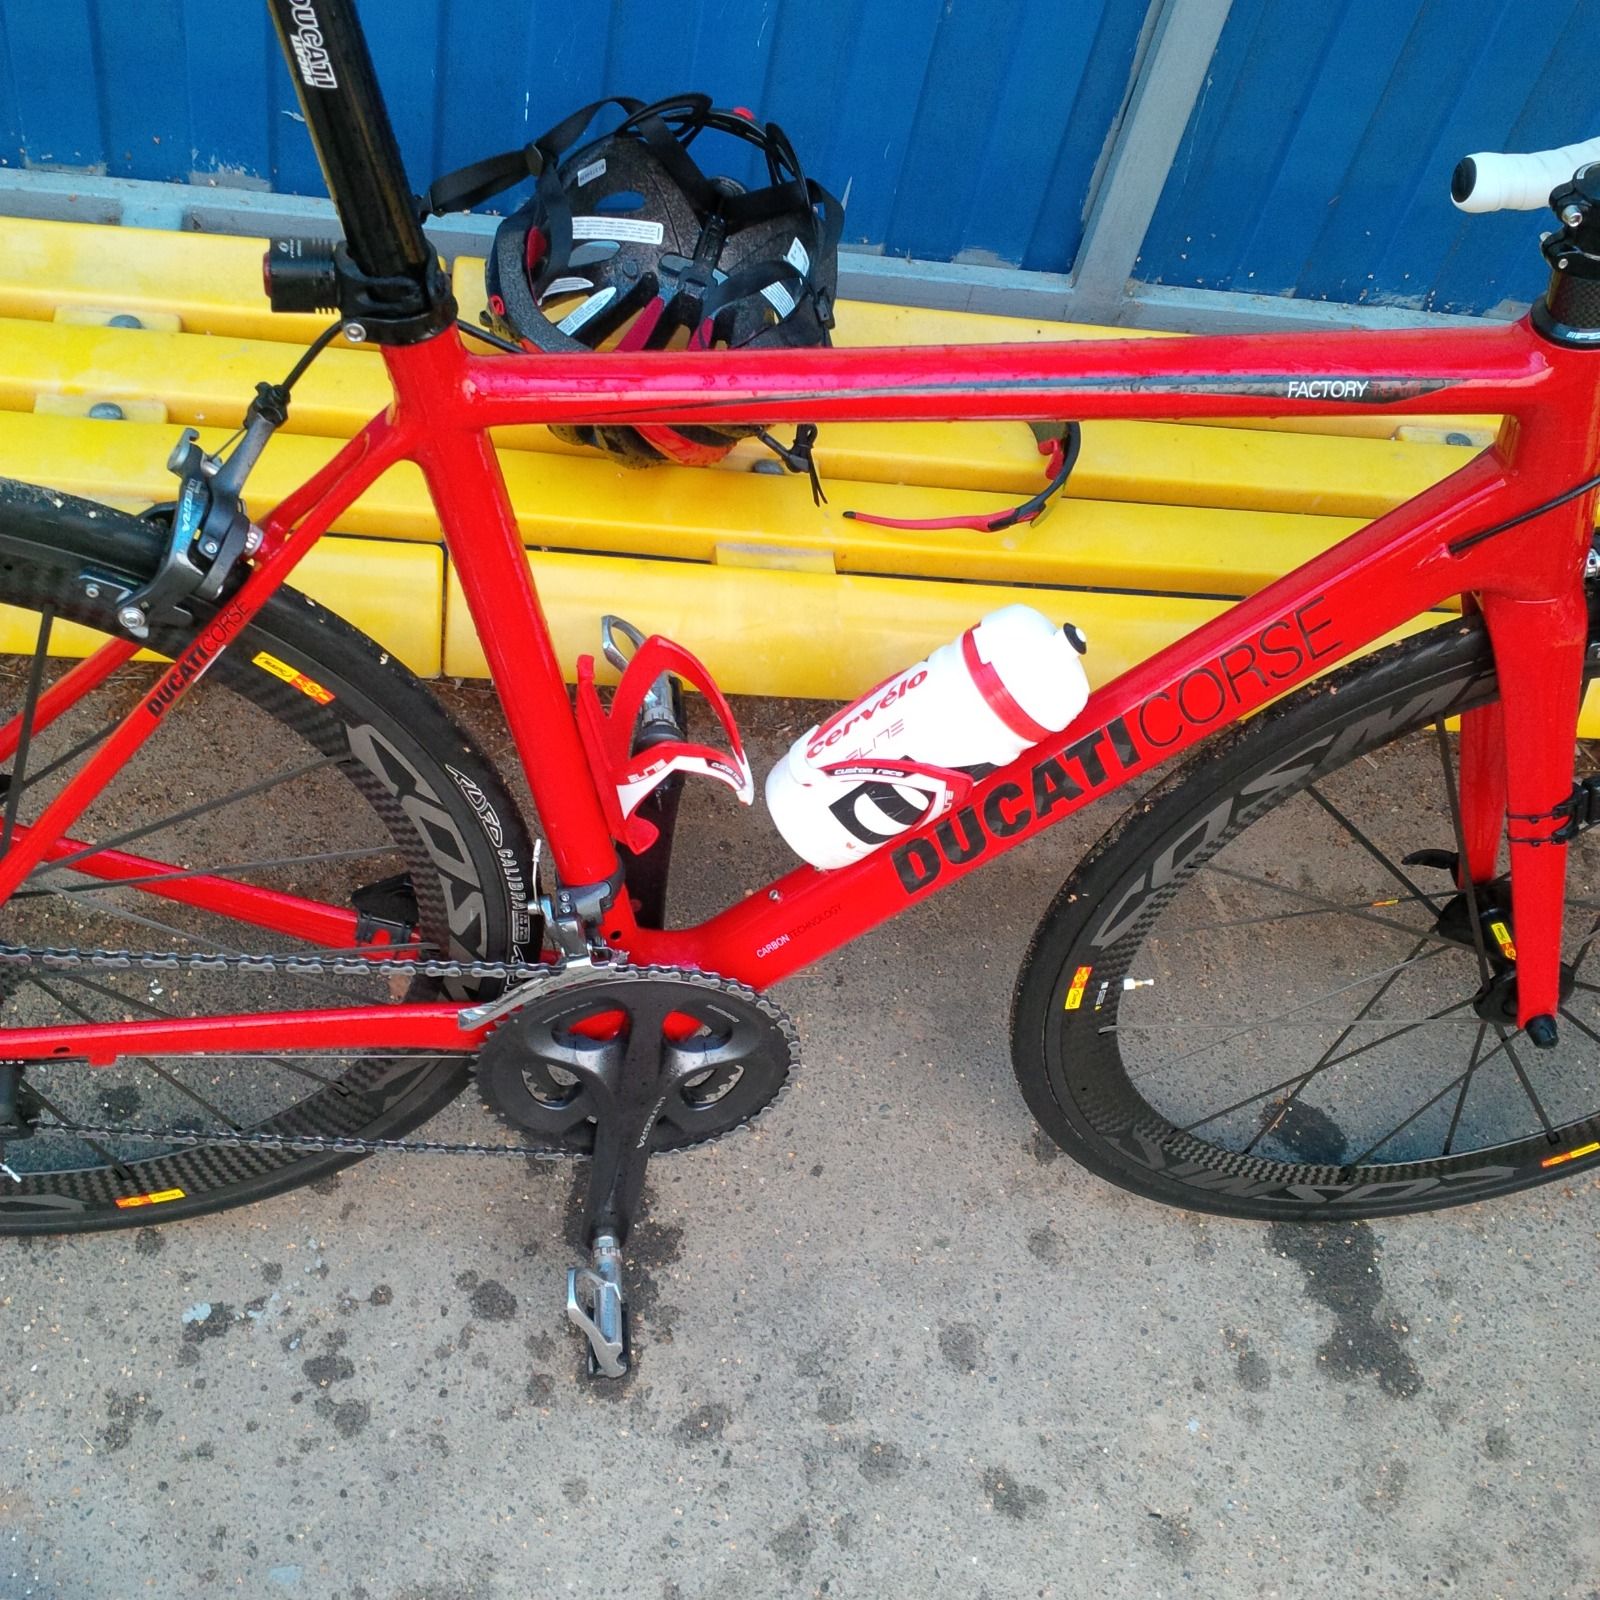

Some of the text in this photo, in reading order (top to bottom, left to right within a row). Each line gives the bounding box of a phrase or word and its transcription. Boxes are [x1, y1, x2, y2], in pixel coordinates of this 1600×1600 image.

[1287, 380, 1369, 399] FACTORY
[146, 600, 250, 718] DUCATI CORSE
[806, 670, 928, 759] cervélo
[834, 766, 905, 777] custom race
[890, 595, 1344, 895] DUCATI CORSE
[756, 933, 790, 959] CARBON
